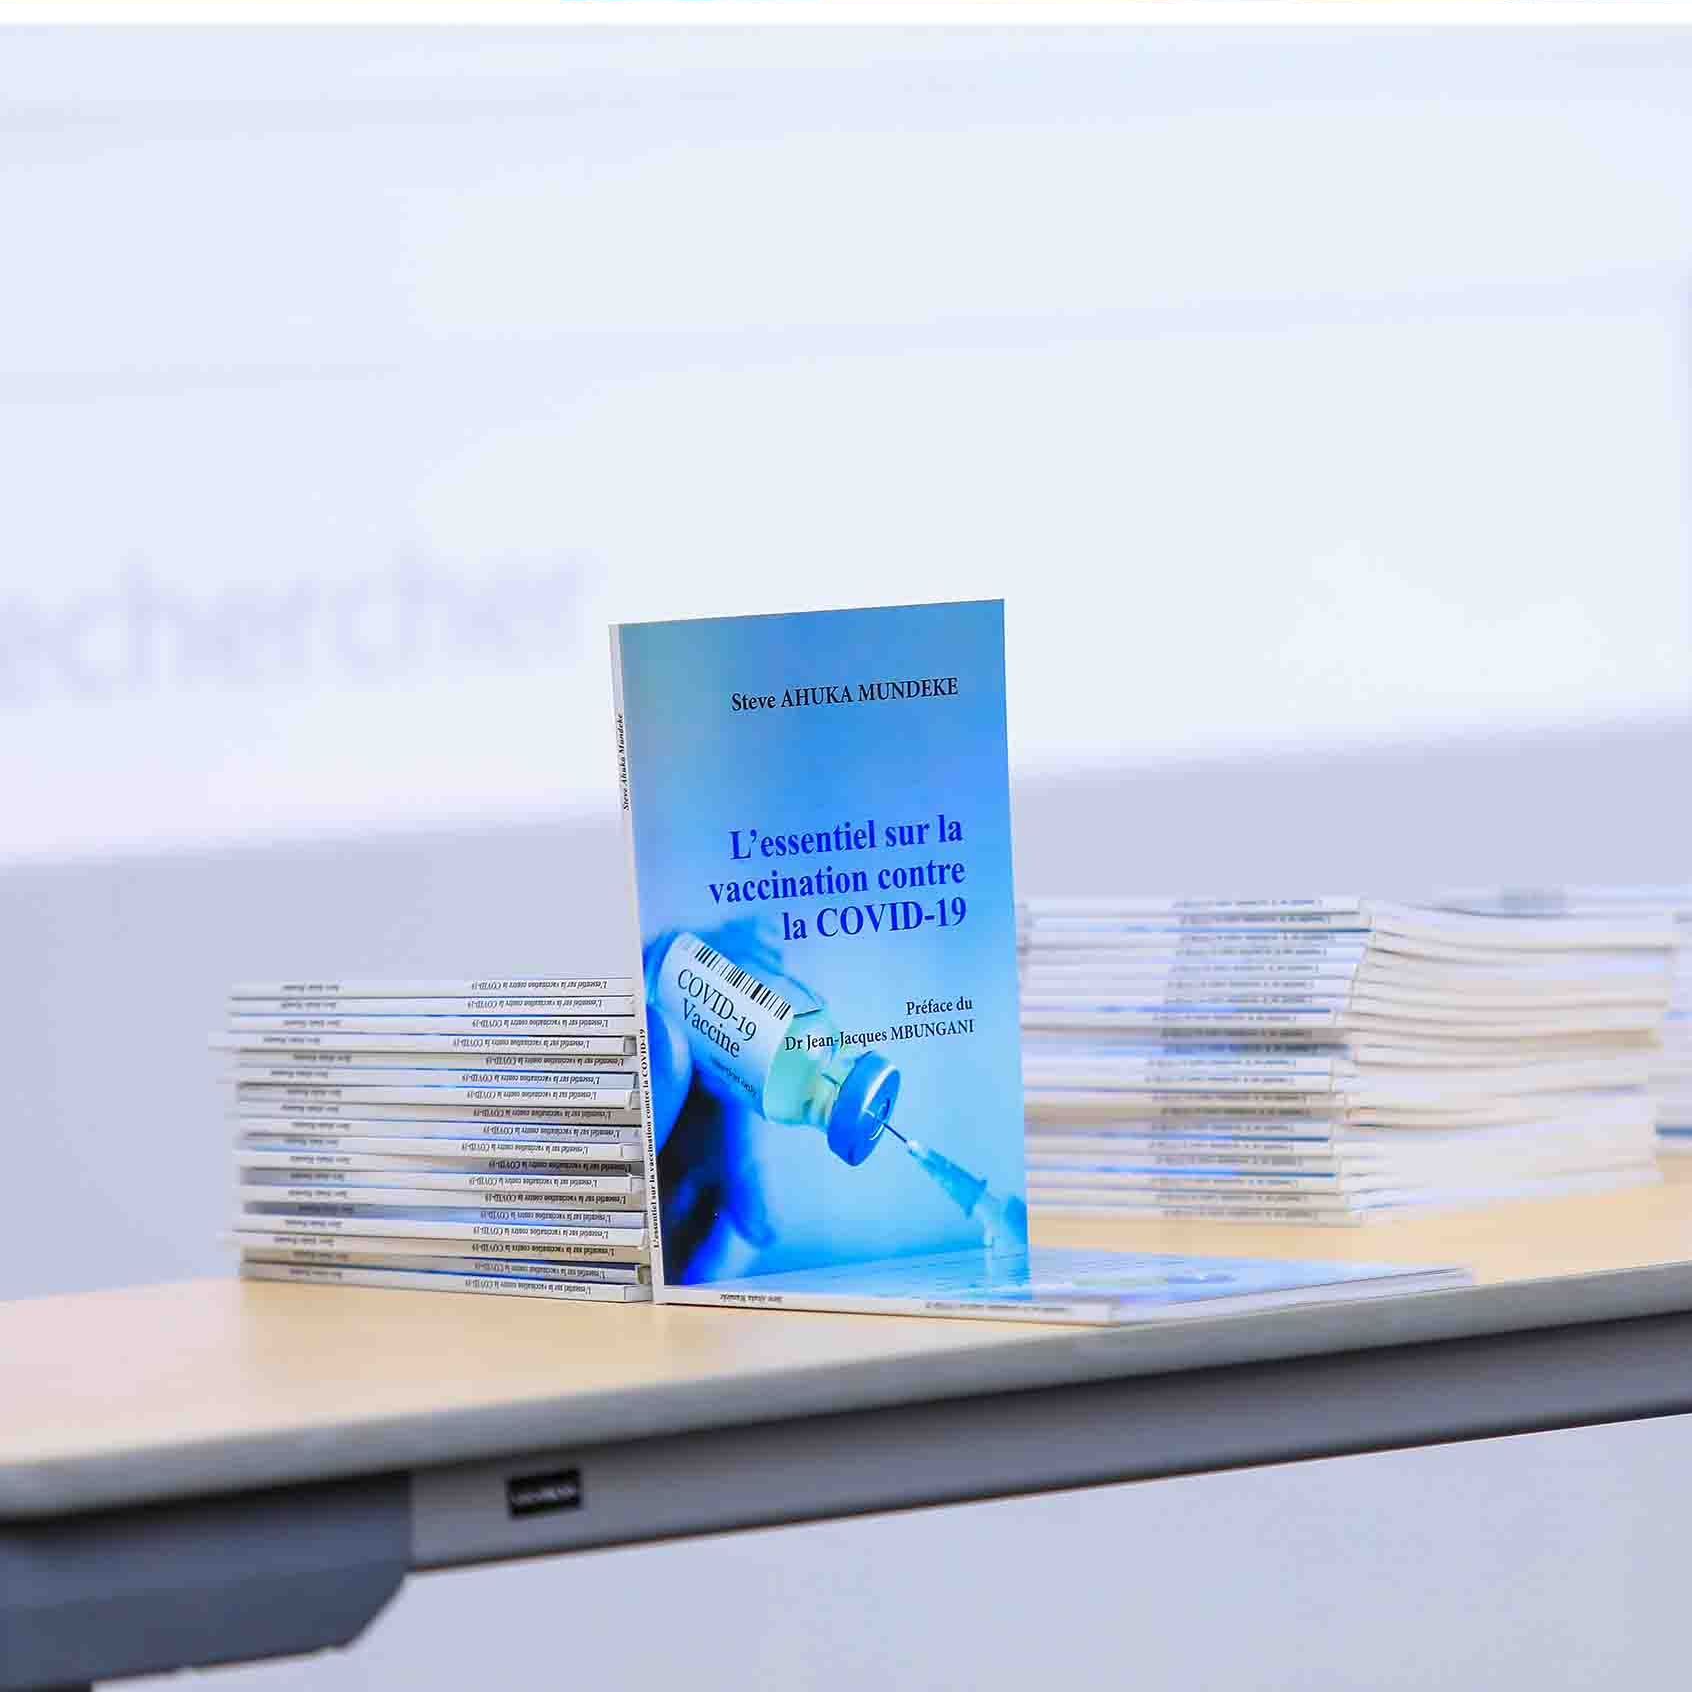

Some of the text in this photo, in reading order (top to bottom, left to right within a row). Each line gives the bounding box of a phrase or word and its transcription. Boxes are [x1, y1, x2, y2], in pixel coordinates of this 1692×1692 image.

[731, 677, 959, 712] Steve AHUKA MUNDEKE
[729, 814, 963, 860] L'essentiel sur la
[709, 859, 966, 905] vaccination contre
[783, 896, 967, 941] la COVID-19
[678, 968, 757, 1042] COVID-19
[683, 997, 740, 1058] Vaccine
[906, 996, 973, 1016] Préface du
[639, 1028, 648, 1078] COVID-19
[785, 1020, 975, 1051] Dr Jean-Jacques MBUNGANI
[643, 1091, 651, 1119] contre
[645, 1121, 655, 1172] vaccination
